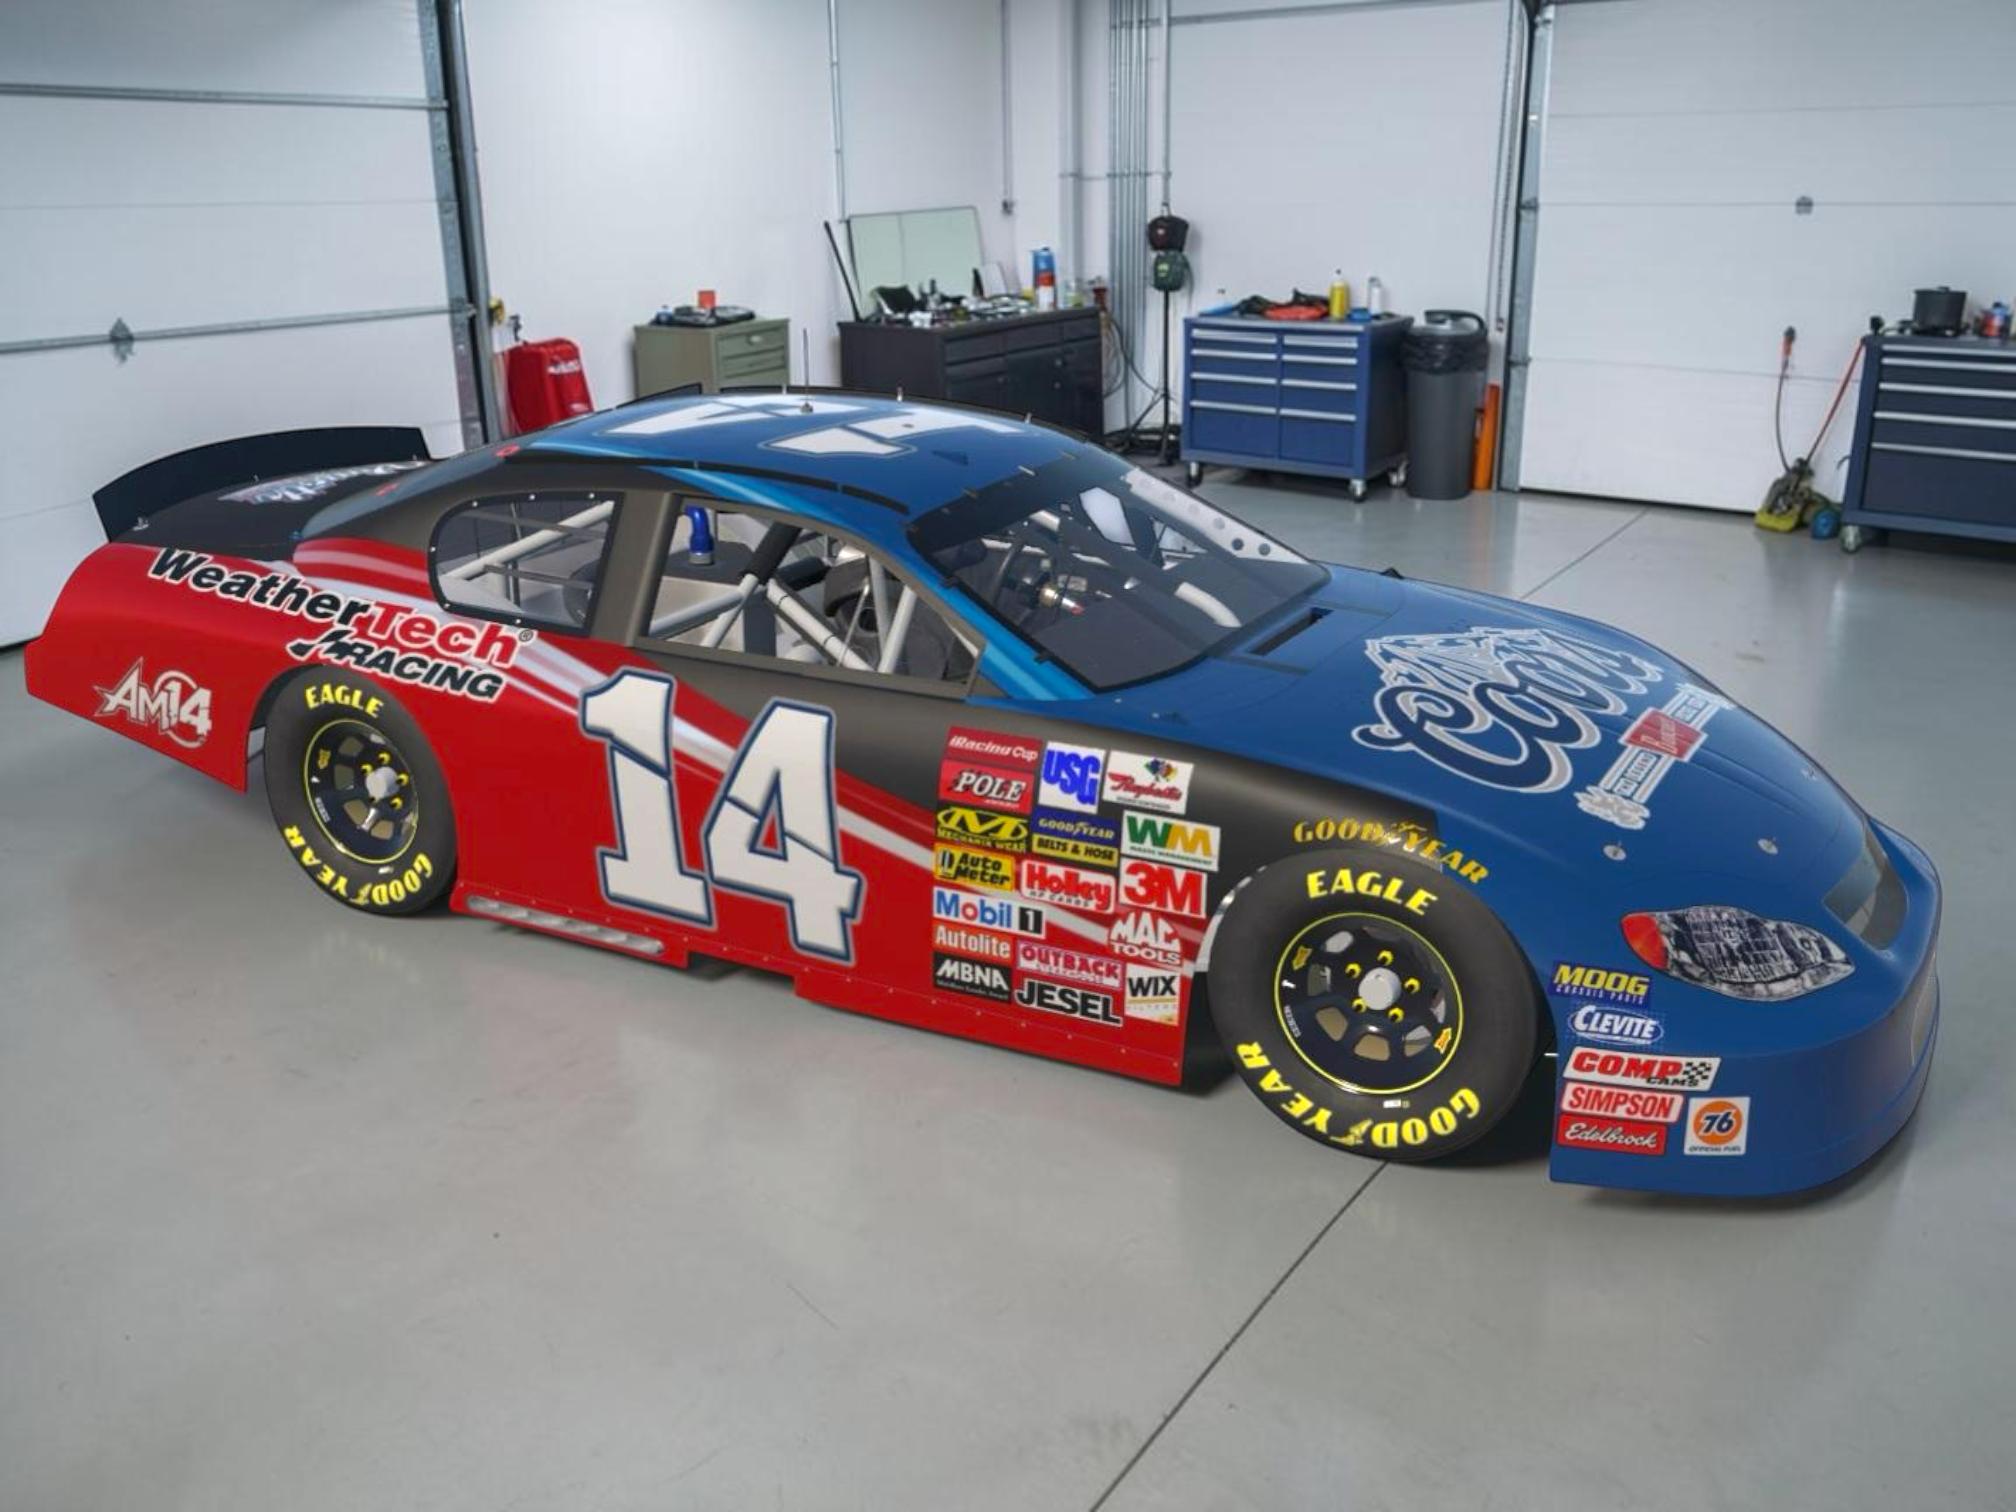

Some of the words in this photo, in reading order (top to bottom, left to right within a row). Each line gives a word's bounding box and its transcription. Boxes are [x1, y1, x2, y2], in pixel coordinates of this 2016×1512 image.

[348, 640, 504, 700] RACING
[304, 683, 385, 720] EAGLE
[1013, 746, 1039, 762] Cup
[954, 771, 1026, 803] POLE
[1042, 748, 1102, 806] USG
[579, 665, 867, 966] 14
[1072, 842, 1081, 856] &
[1084, 845, 1114, 861] HOSE
[1126, 815, 1213, 857] WM
[1293, 817, 1490, 884] GOODYEAR
[284, 824, 433, 906] GOODYEAR
[955, 865, 1011, 886] Meter
[959, 851, 1002, 872] Auto
[1125, 860, 1203, 914] 3M
[1306, 869, 1438, 916] EAGLE
[936, 890, 1012, 929] Mobil
[935, 925, 1011, 959] Autolite
[1110, 911, 1179, 945] MAC
[1021, 943, 1120, 979] OUTBACK
[1112, 942, 1182, 966] TOOLS
[936, 958, 1009, 992] MBNA
[1127, 975, 1177, 998] WIX
[1553, 964, 1650, 996] MOOG
[1015, 980, 1122, 1025] JESEL
[1573, 1003, 1660, 1039] CLEVITE
[1572, 1051, 1685, 1080] COMP
[1645, 1075, 1700, 1088] CAMS
[1236, 1041, 1481, 1148] GOODYEAR
[1568, 1086, 1676, 1119] SIMPSON
[1564, 1121, 1658, 1149] Edelbrock
[1702, 1109, 1736, 1135] 76
